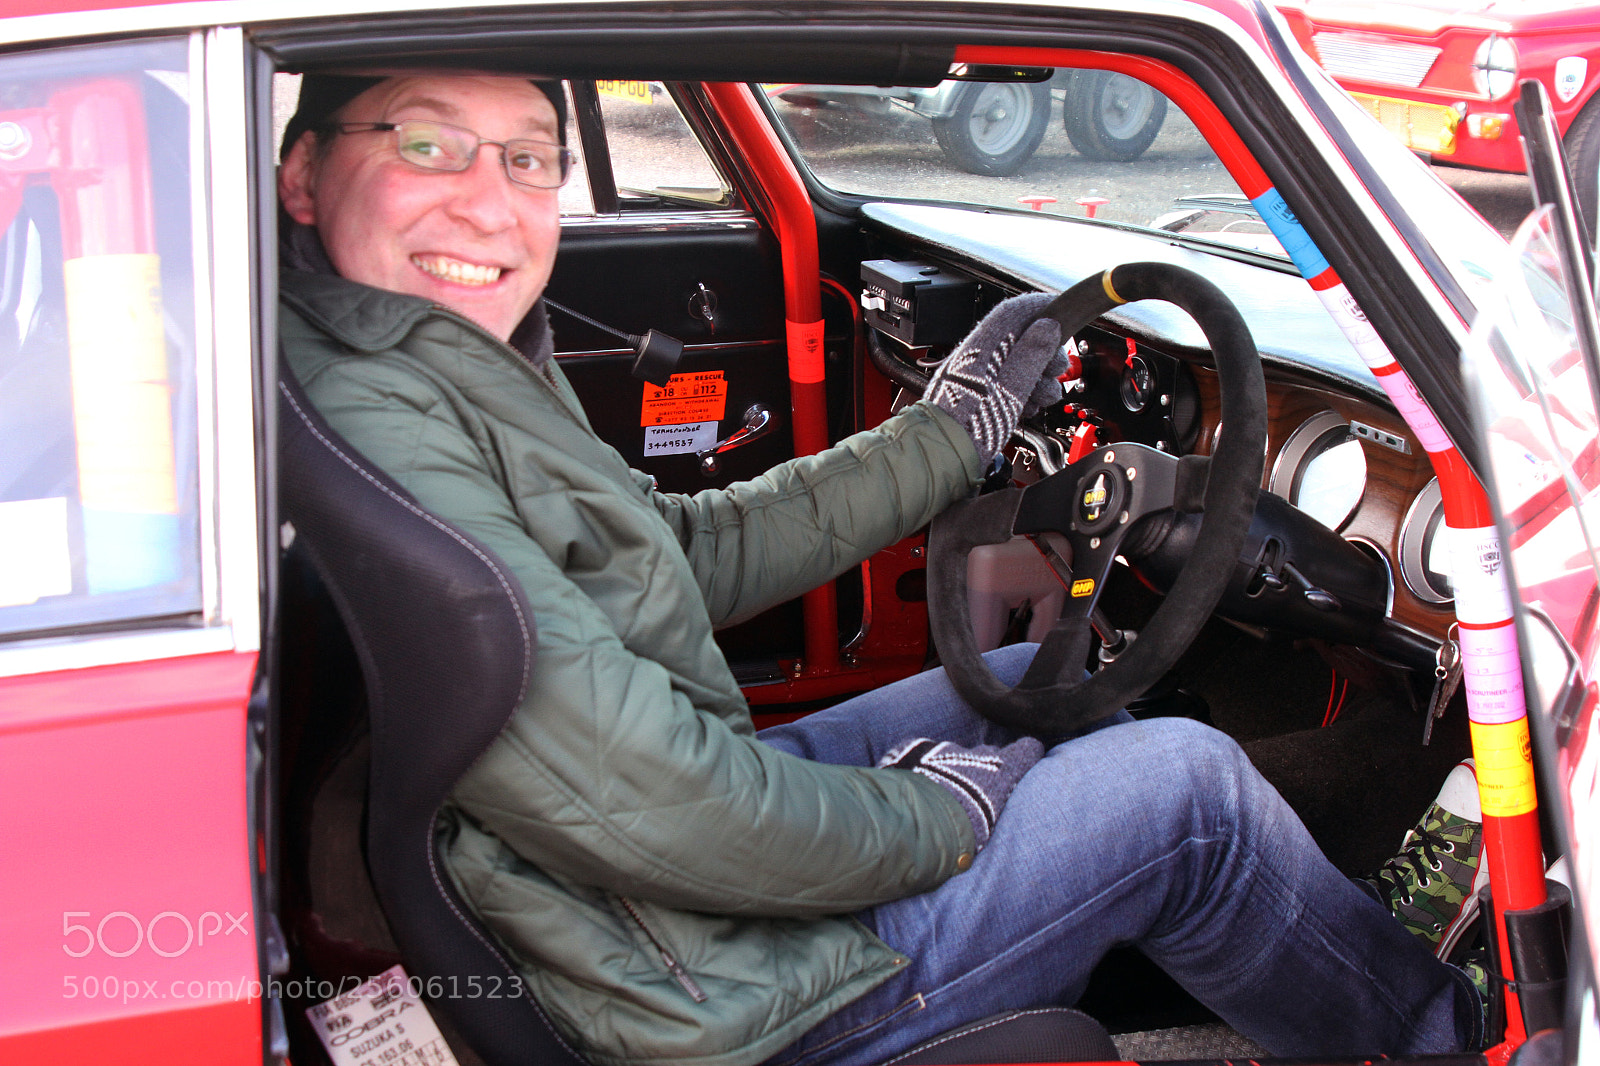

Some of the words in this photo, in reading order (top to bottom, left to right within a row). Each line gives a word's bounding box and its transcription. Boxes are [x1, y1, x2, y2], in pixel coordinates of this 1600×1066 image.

[663, 387, 675, 397] 18
[700, 385, 717, 394] 112
[651, 425, 701, 434] TRANSPONDER
[648, 438, 693, 449] 3449537
[1084, 489, 1105, 505] OMP
[1072, 581, 1093, 596] OMP
[1471, 688, 1508, 697] SCRUTINEER
[330, 1000, 415, 1047] COBRA
[350, 1029, 396, 1058] SUZUKA
[395, 1022, 405, 1034] S
